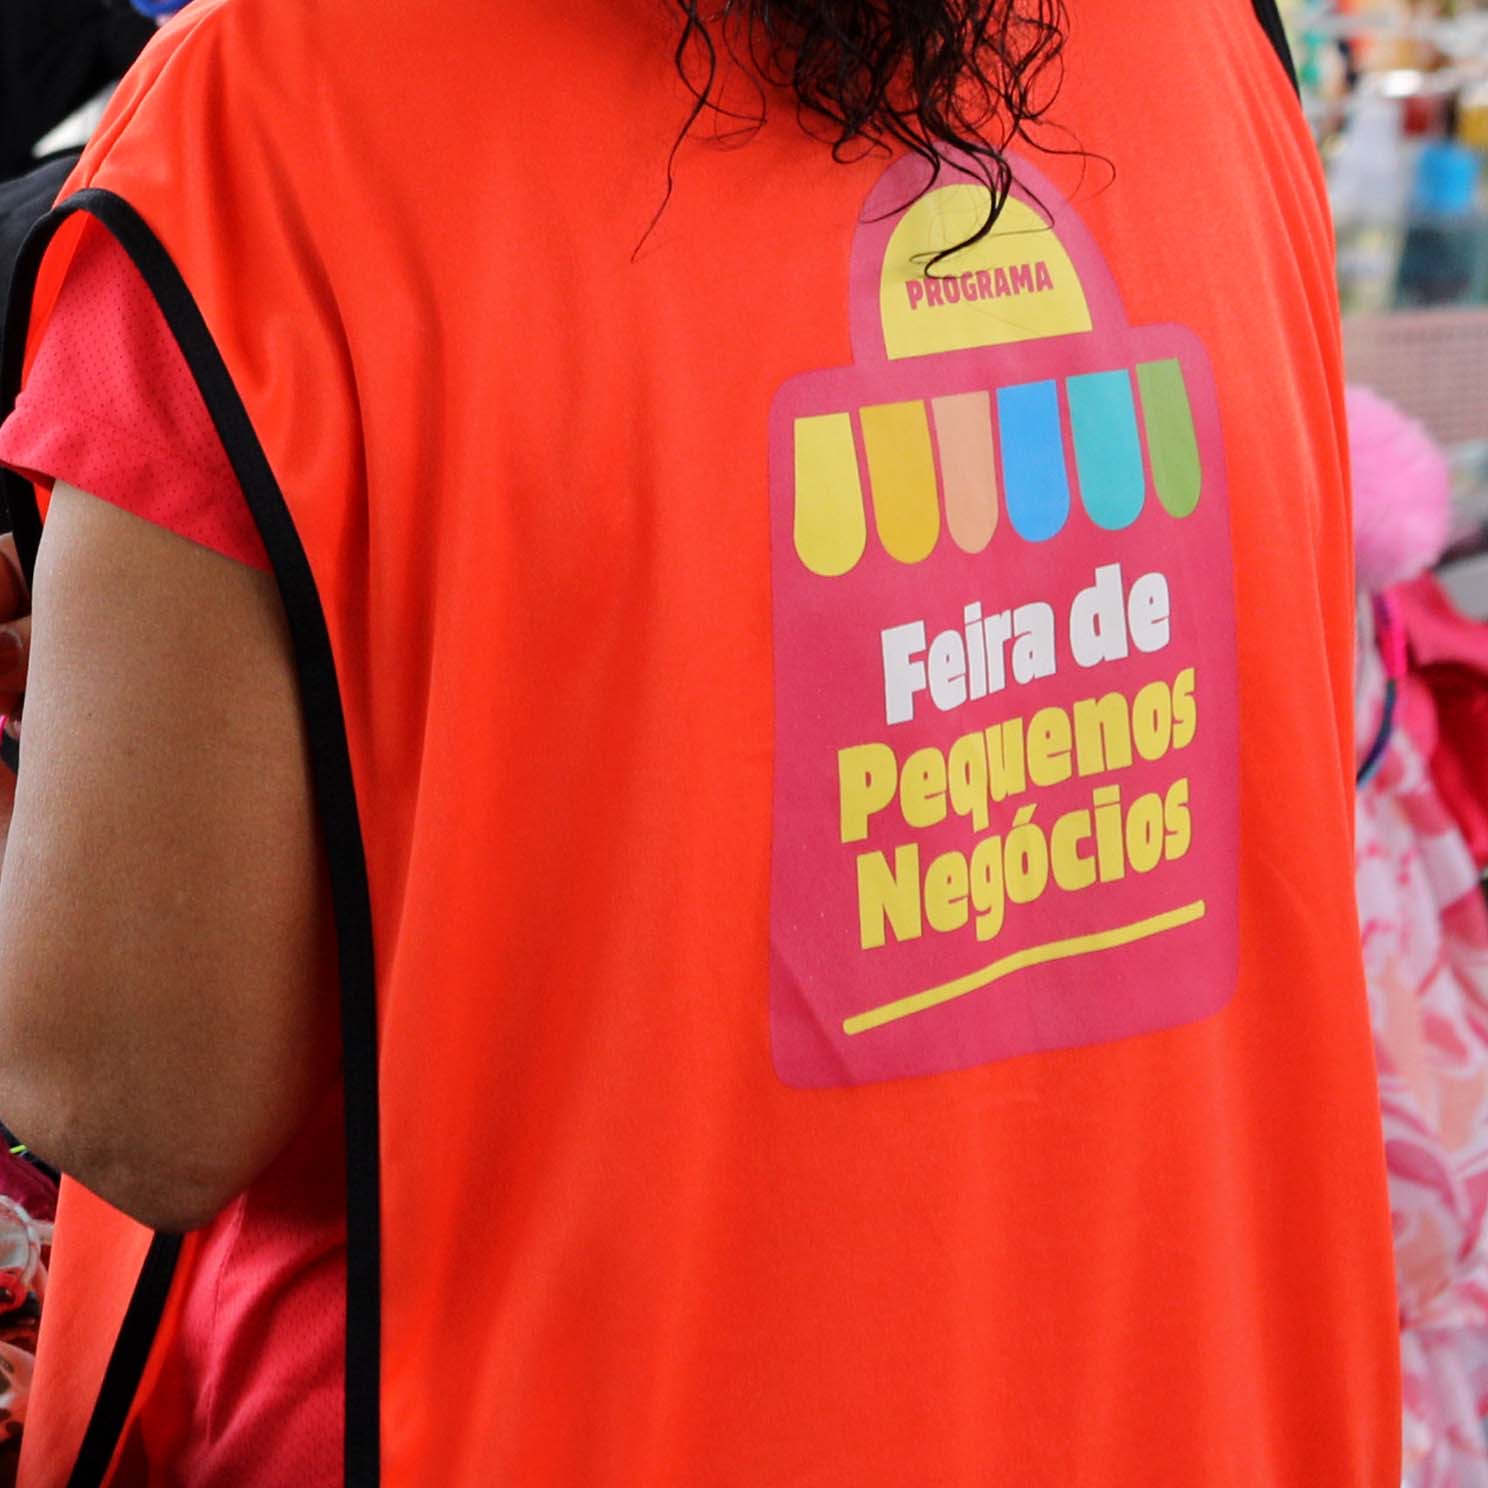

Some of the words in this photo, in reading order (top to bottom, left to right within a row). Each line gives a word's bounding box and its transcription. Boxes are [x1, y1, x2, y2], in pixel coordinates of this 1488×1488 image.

[905, 260, 1054, 310] PROGRAMA
[881, 601, 1055, 725] Feira
[1068, 563, 1171, 670] de
[837, 666, 1198, 844] Pequenos
[856, 777, 1192, 950] Negócios
